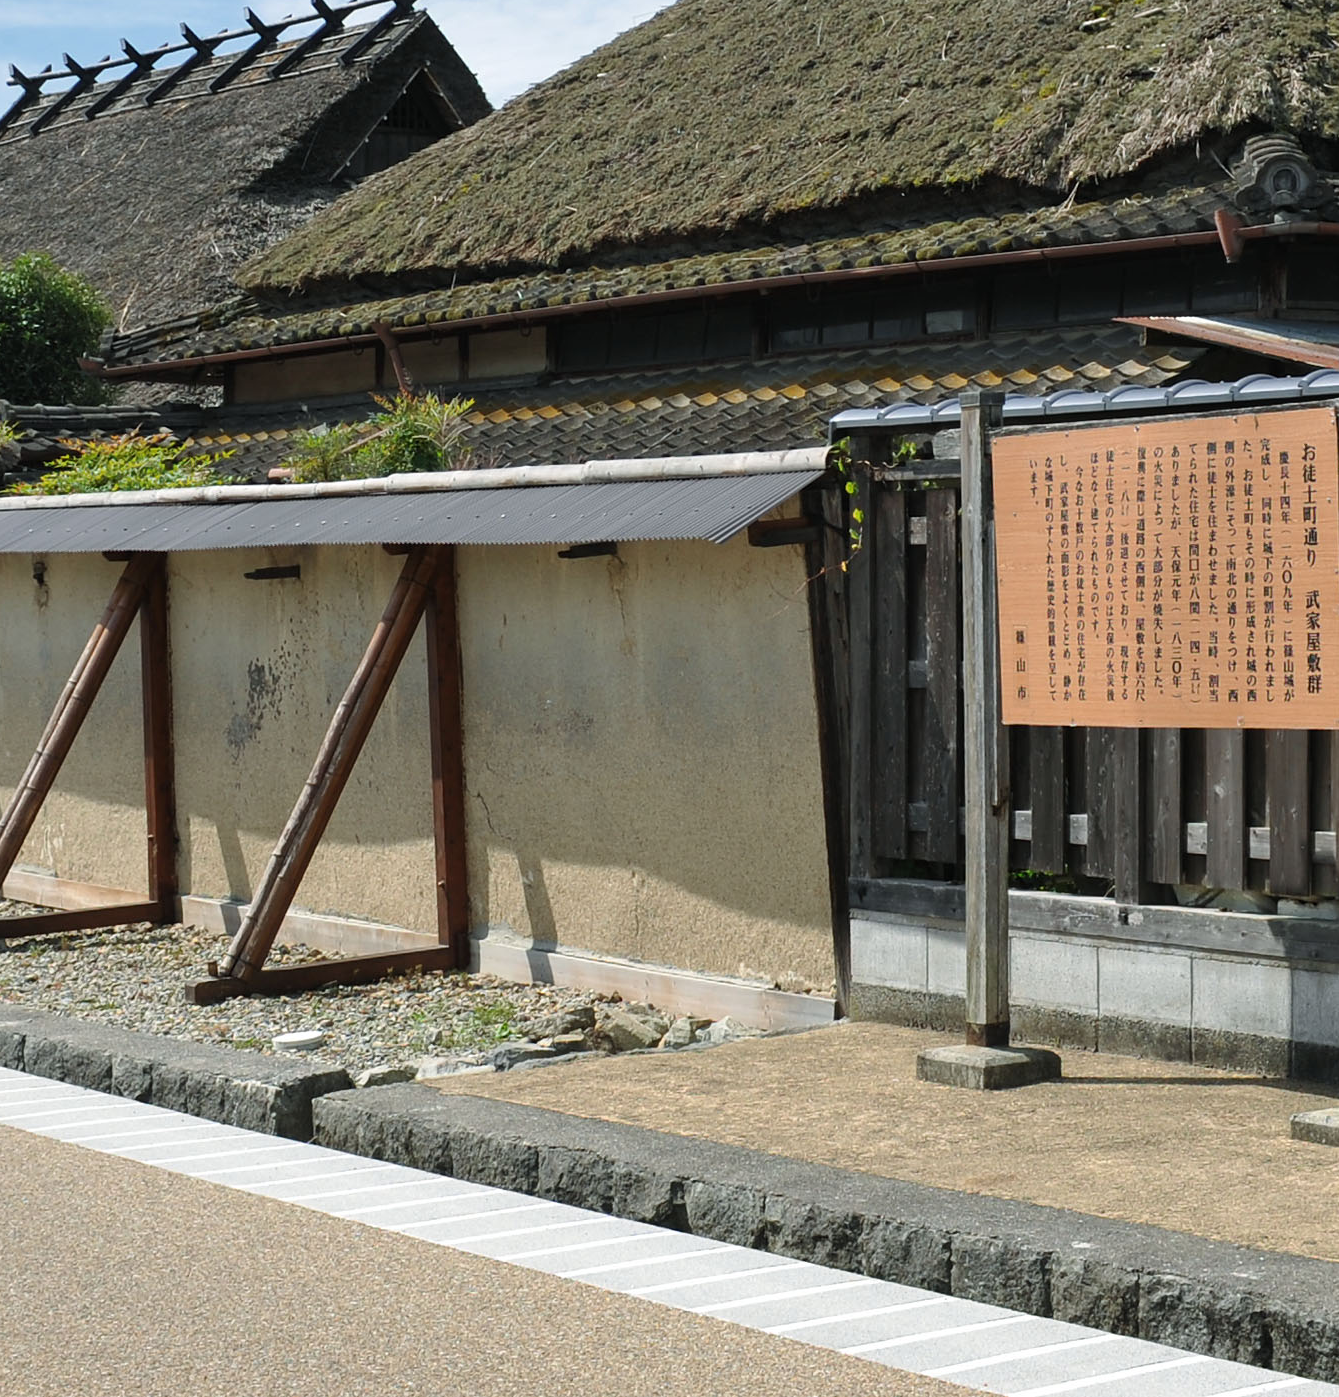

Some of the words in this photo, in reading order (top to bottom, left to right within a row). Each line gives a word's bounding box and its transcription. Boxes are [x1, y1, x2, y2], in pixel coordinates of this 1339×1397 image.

[1029, 459, 1039, 506] います。
[1301, 442, 1319, 568] お徒士町通り
[1304, 589, 1323, 695] 武家屋敷群
